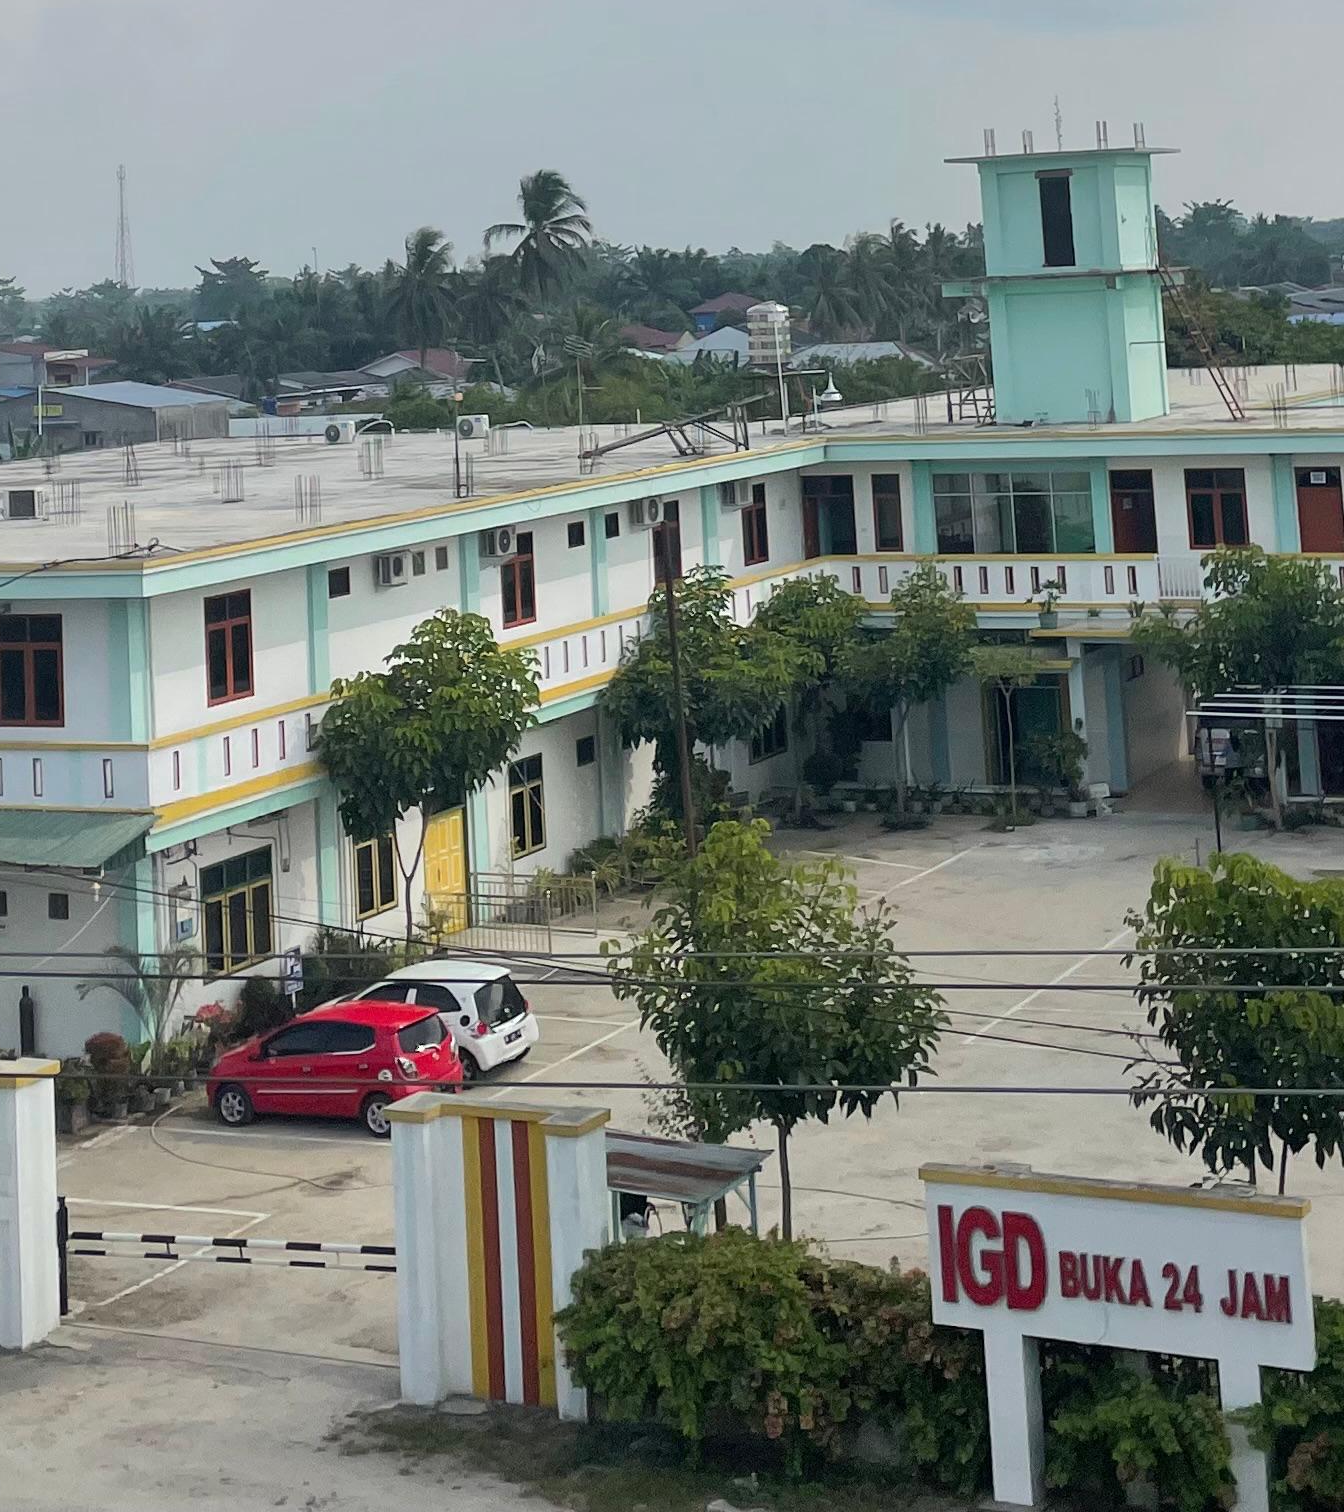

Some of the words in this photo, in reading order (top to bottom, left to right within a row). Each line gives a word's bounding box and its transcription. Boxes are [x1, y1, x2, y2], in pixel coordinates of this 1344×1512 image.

[937, 1204, 1049, 1311] IGD
[1058, 1249, 1154, 1308] BUKA
[1162, 1262, 1204, 1314] 24
[1220, 1268, 1293, 1324] JAM
